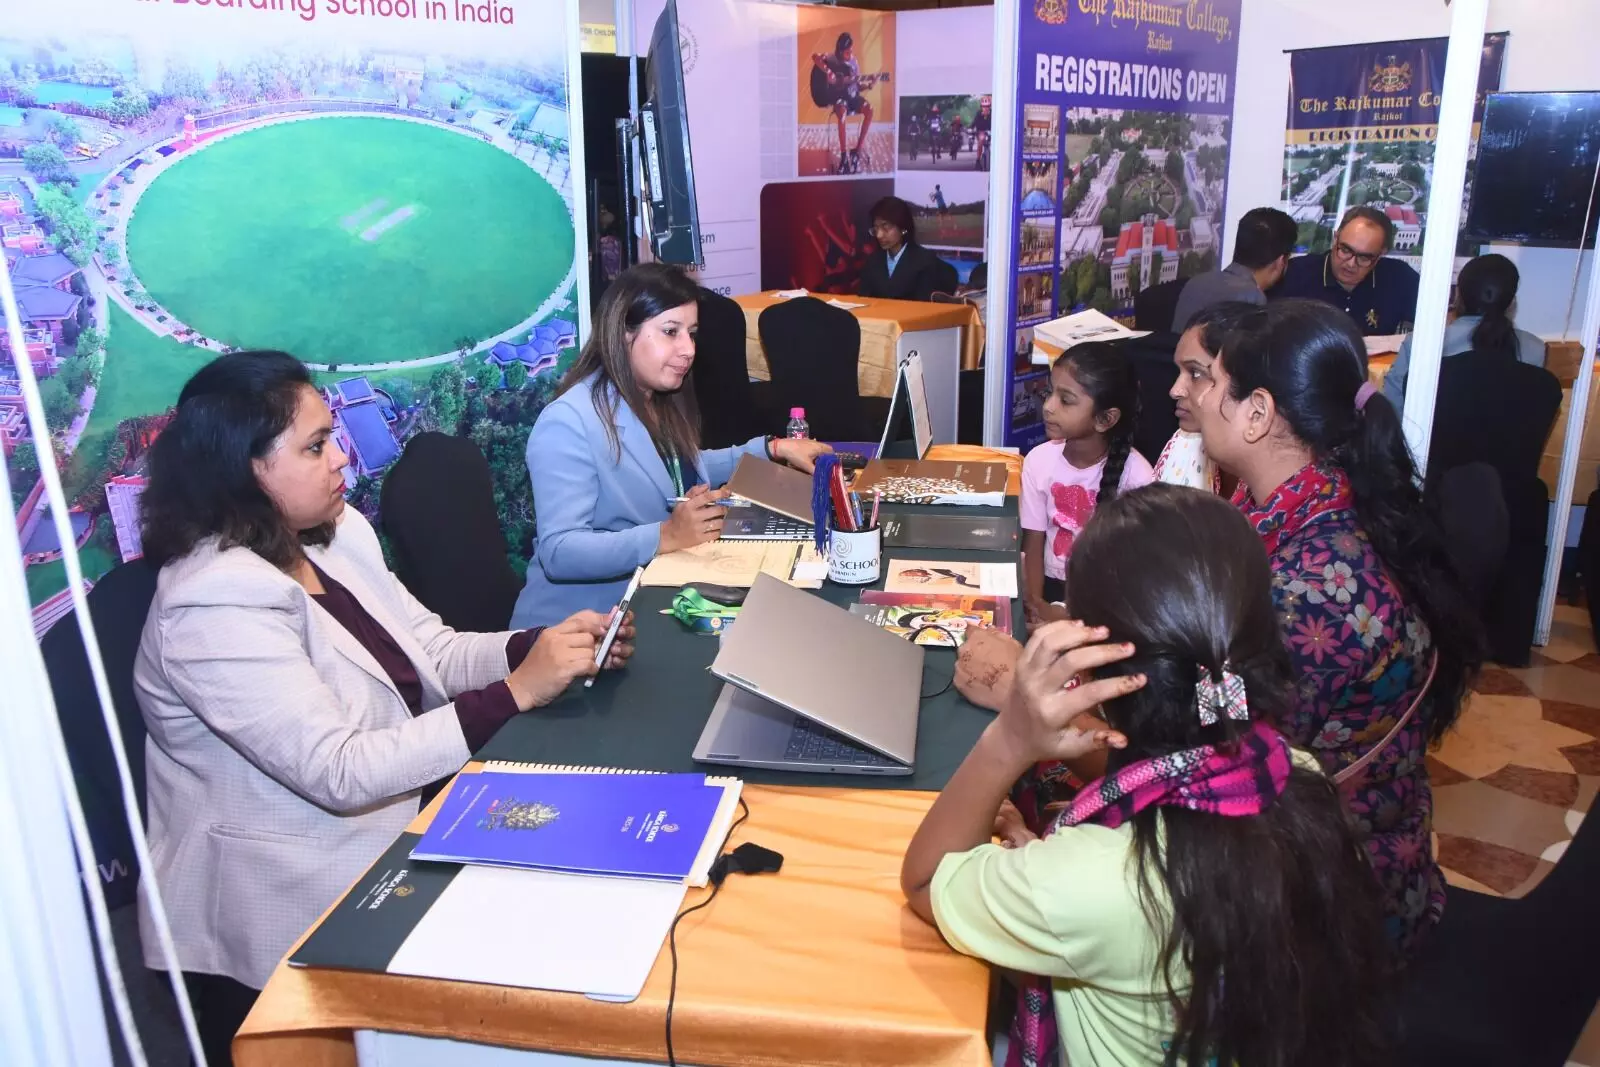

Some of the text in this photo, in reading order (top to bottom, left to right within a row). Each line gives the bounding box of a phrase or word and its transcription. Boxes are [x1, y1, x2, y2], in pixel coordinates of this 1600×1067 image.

[326, 0, 416, 19] School
[425, 0, 447, 20] in
[455, 0, 514, 25] India
[1111, 0, 1183, 30] Rajkumar
[1035, 53, 1227, 104] REGISTRATIONS OPEN
[1300, 98, 1329, 113] The
[1333, 94, 1412, 113] Rajkumar
